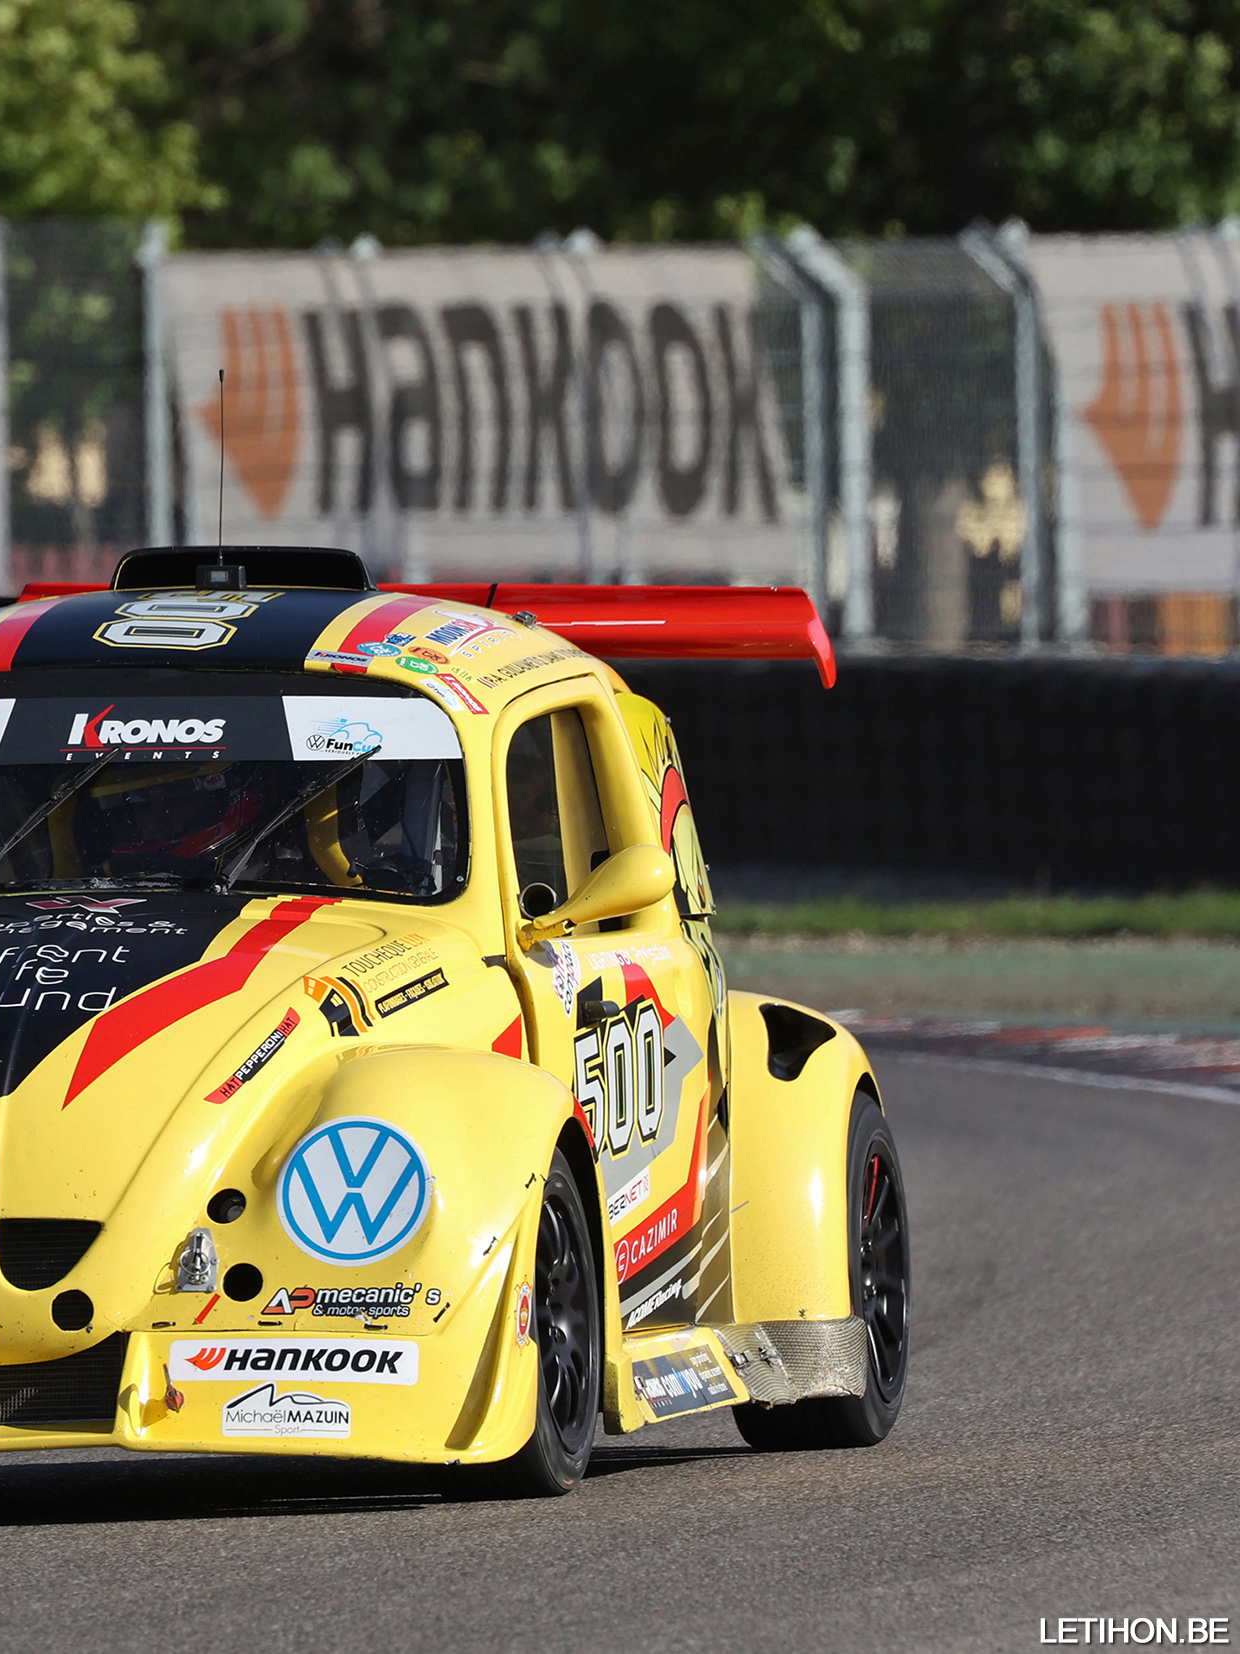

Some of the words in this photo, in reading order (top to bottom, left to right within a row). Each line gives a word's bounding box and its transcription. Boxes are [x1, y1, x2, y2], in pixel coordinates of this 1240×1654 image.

[68, 704, 227, 747] KRONOS
[65, 751, 220, 762] EVENTS
[235, 1029, 283, 1080] PEPPERONI
[573, 998, 665, 1161] 500
[630, 1208, 678, 1265] CAZIMIR
[313, 1304, 324, 1316] &
[368, 1304, 410, 1317] sports
[225, 1408, 287, 1424] Michaël
[287, 1410, 349, 1425] MAZUIN
[274, 1424, 301, 1436] Sport
